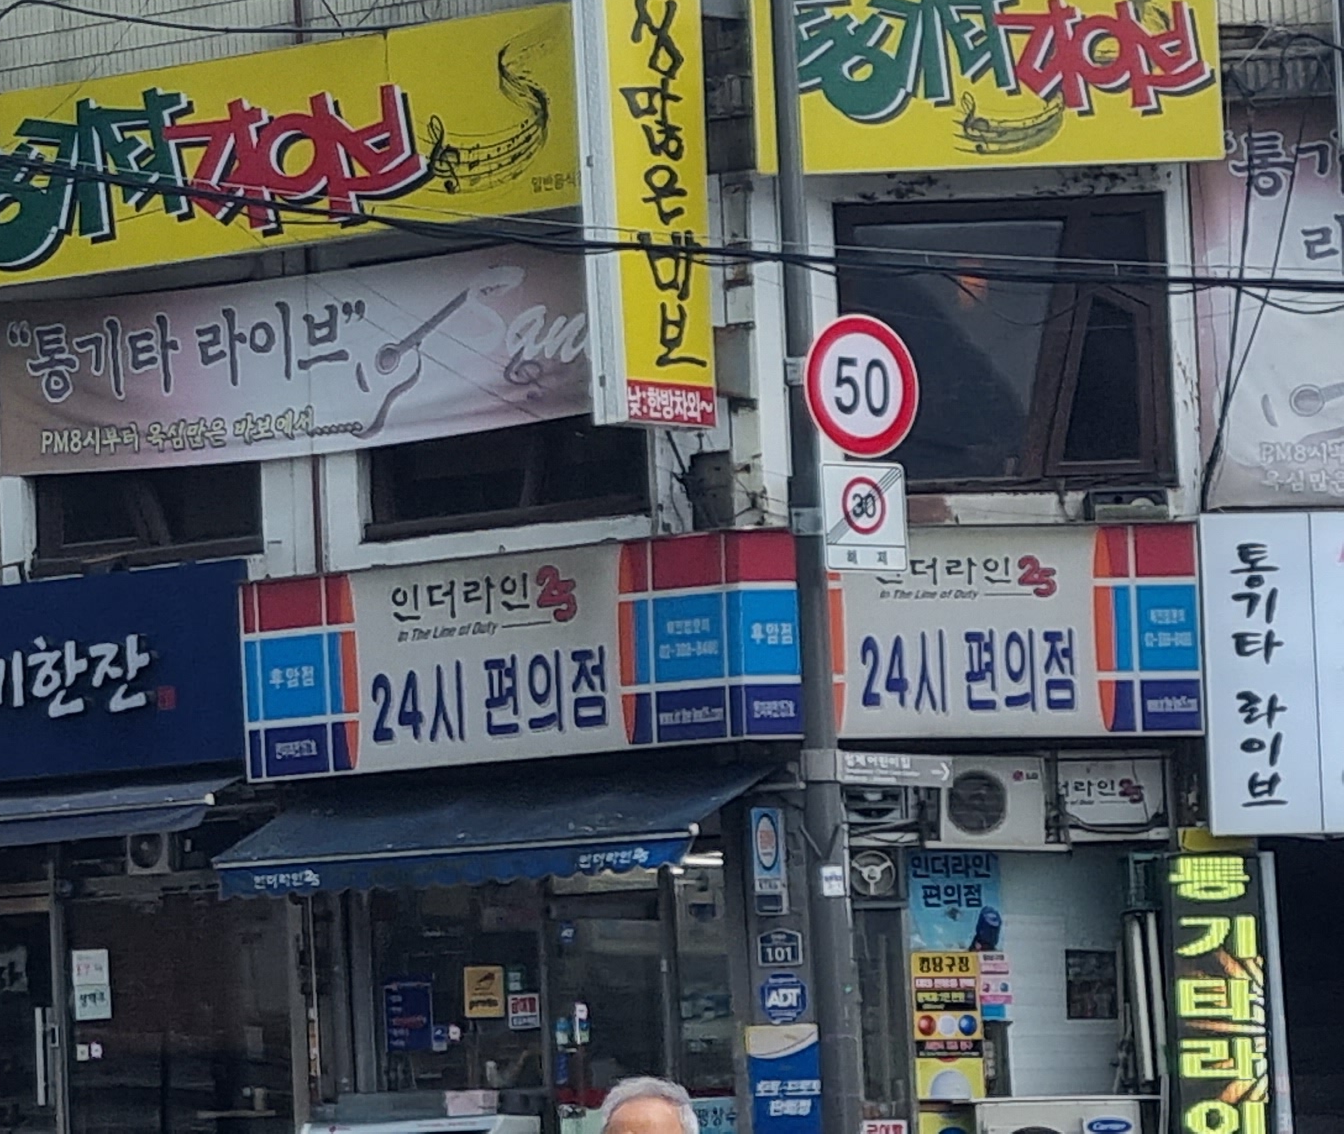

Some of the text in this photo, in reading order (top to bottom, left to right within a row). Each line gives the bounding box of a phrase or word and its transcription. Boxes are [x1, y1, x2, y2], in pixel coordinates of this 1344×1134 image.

[833, 357, 891, 417] 50
[41, 420, 140, 454] PM8시부터
[146, 416, 227, 452] 욕심많은
[852, 492, 876, 519] 30
[893, 589, 912, 600] The
[914, 589, 937, 600] Line
[939, 589, 951, 600] of
[953, 589, 979, 601] Duty
[1229, 542, 1285, 665] 통기타
[411, 628, 431, 641] The
[432, 626, 457, 639] Line
[458, 623, 472, 636] of
[473, 621, 498, 638] Duty
[751, 623, 793, 645] 후암점
[269, 666, 315, 689] 후암점
[861, 627, 1075, 712] 24시 편의점
[371, 645, 607, 743] 24시 편의점
[1235, 690, 1288, 808] 라이브
[1025, 771, 1038, 781] LG
[912, 854, 992, 879] 인더라인
[921, 883, 984, 908] 편의점
[765, 945, 794, 963] 101
[765, 988, 802, 1008] ADT
